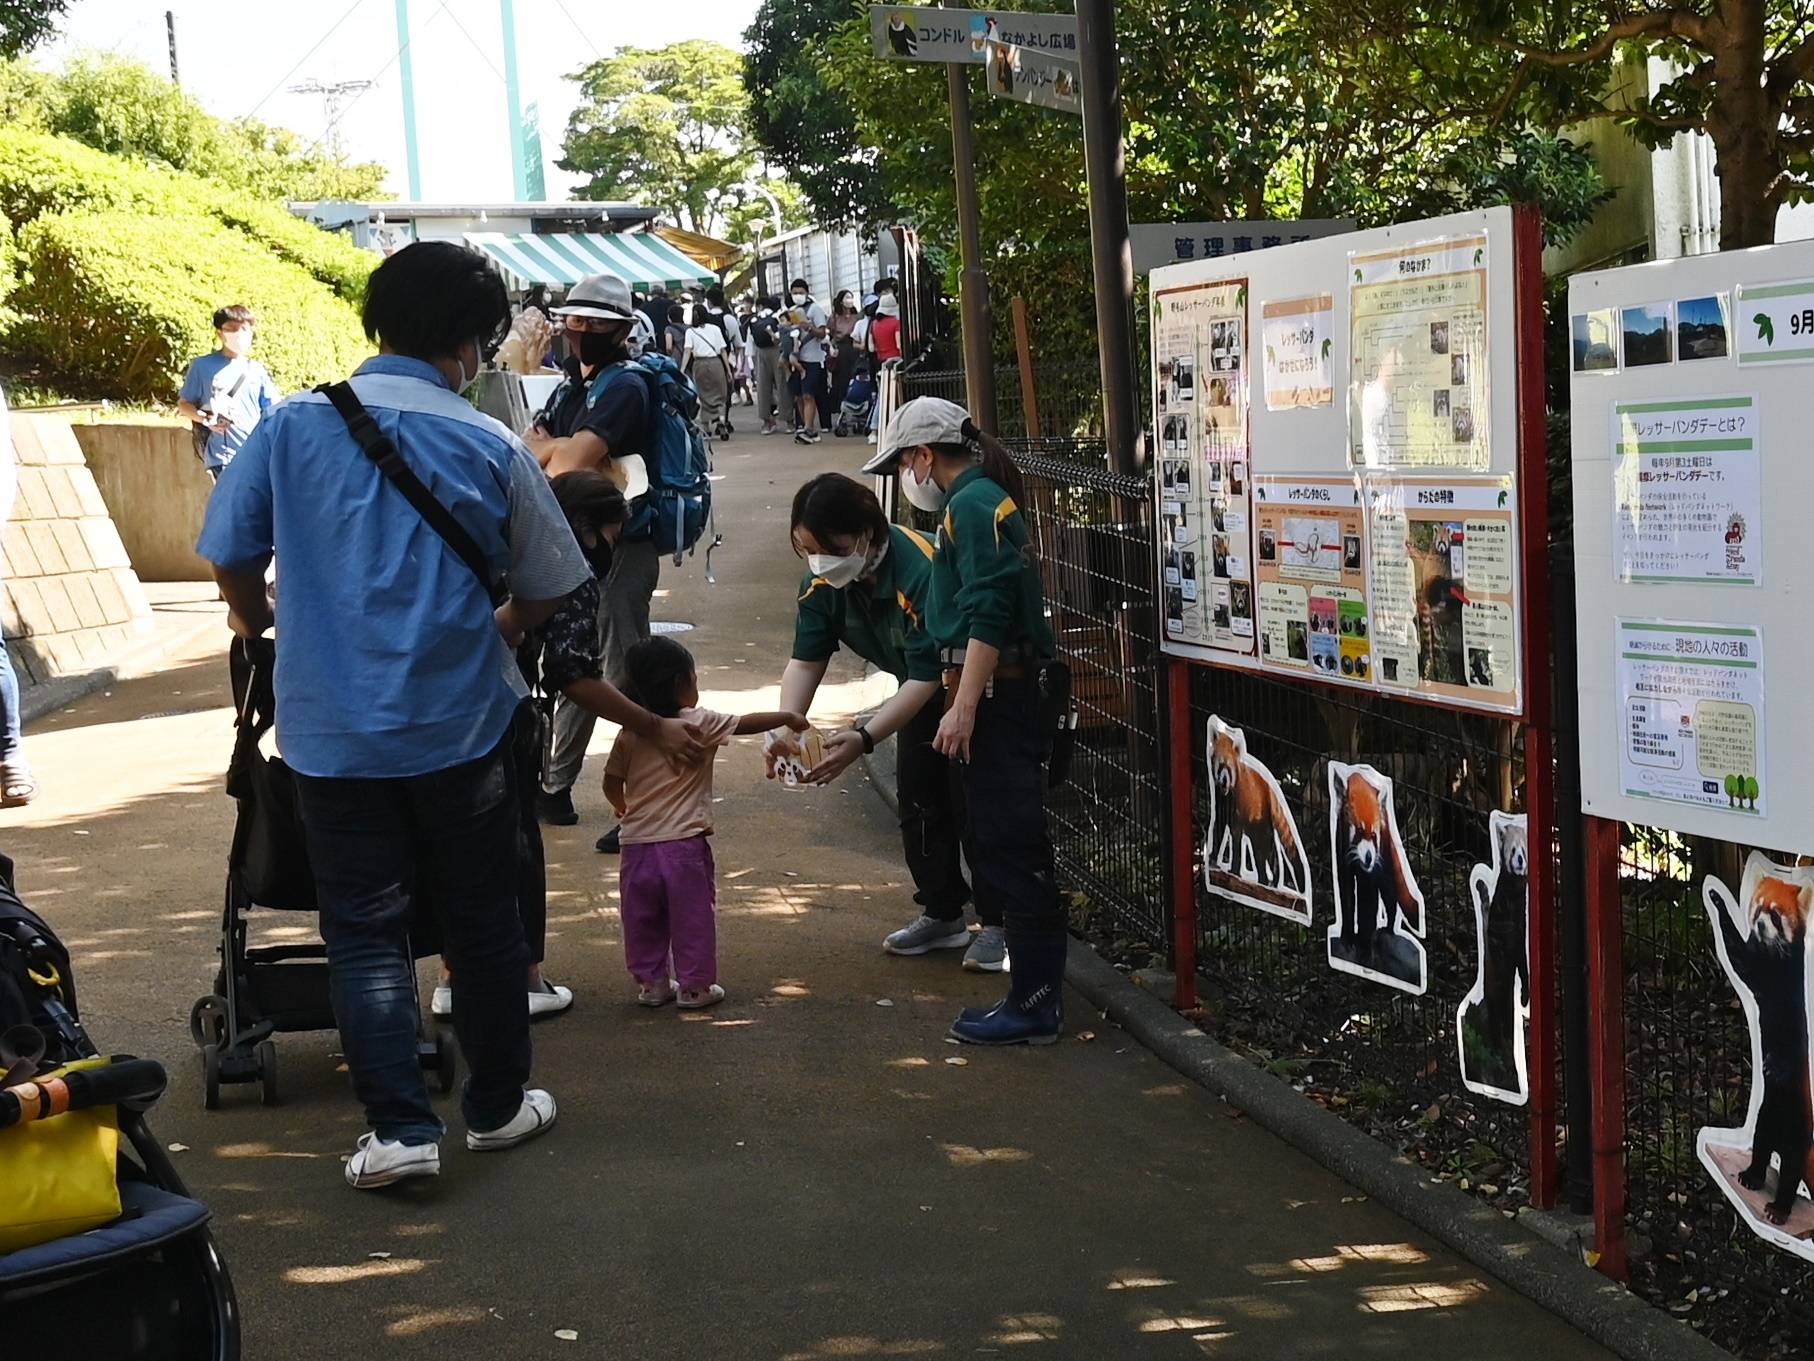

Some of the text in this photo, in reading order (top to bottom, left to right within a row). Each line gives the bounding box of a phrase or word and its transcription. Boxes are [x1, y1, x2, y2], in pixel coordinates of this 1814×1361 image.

[919, 27, 1077, 50] コンドル なかよし広場
[1621, 416, 1746, 436] レッサーパンダデーとは？
[1675, 637, 1749, 658] 現地の人々の活動
